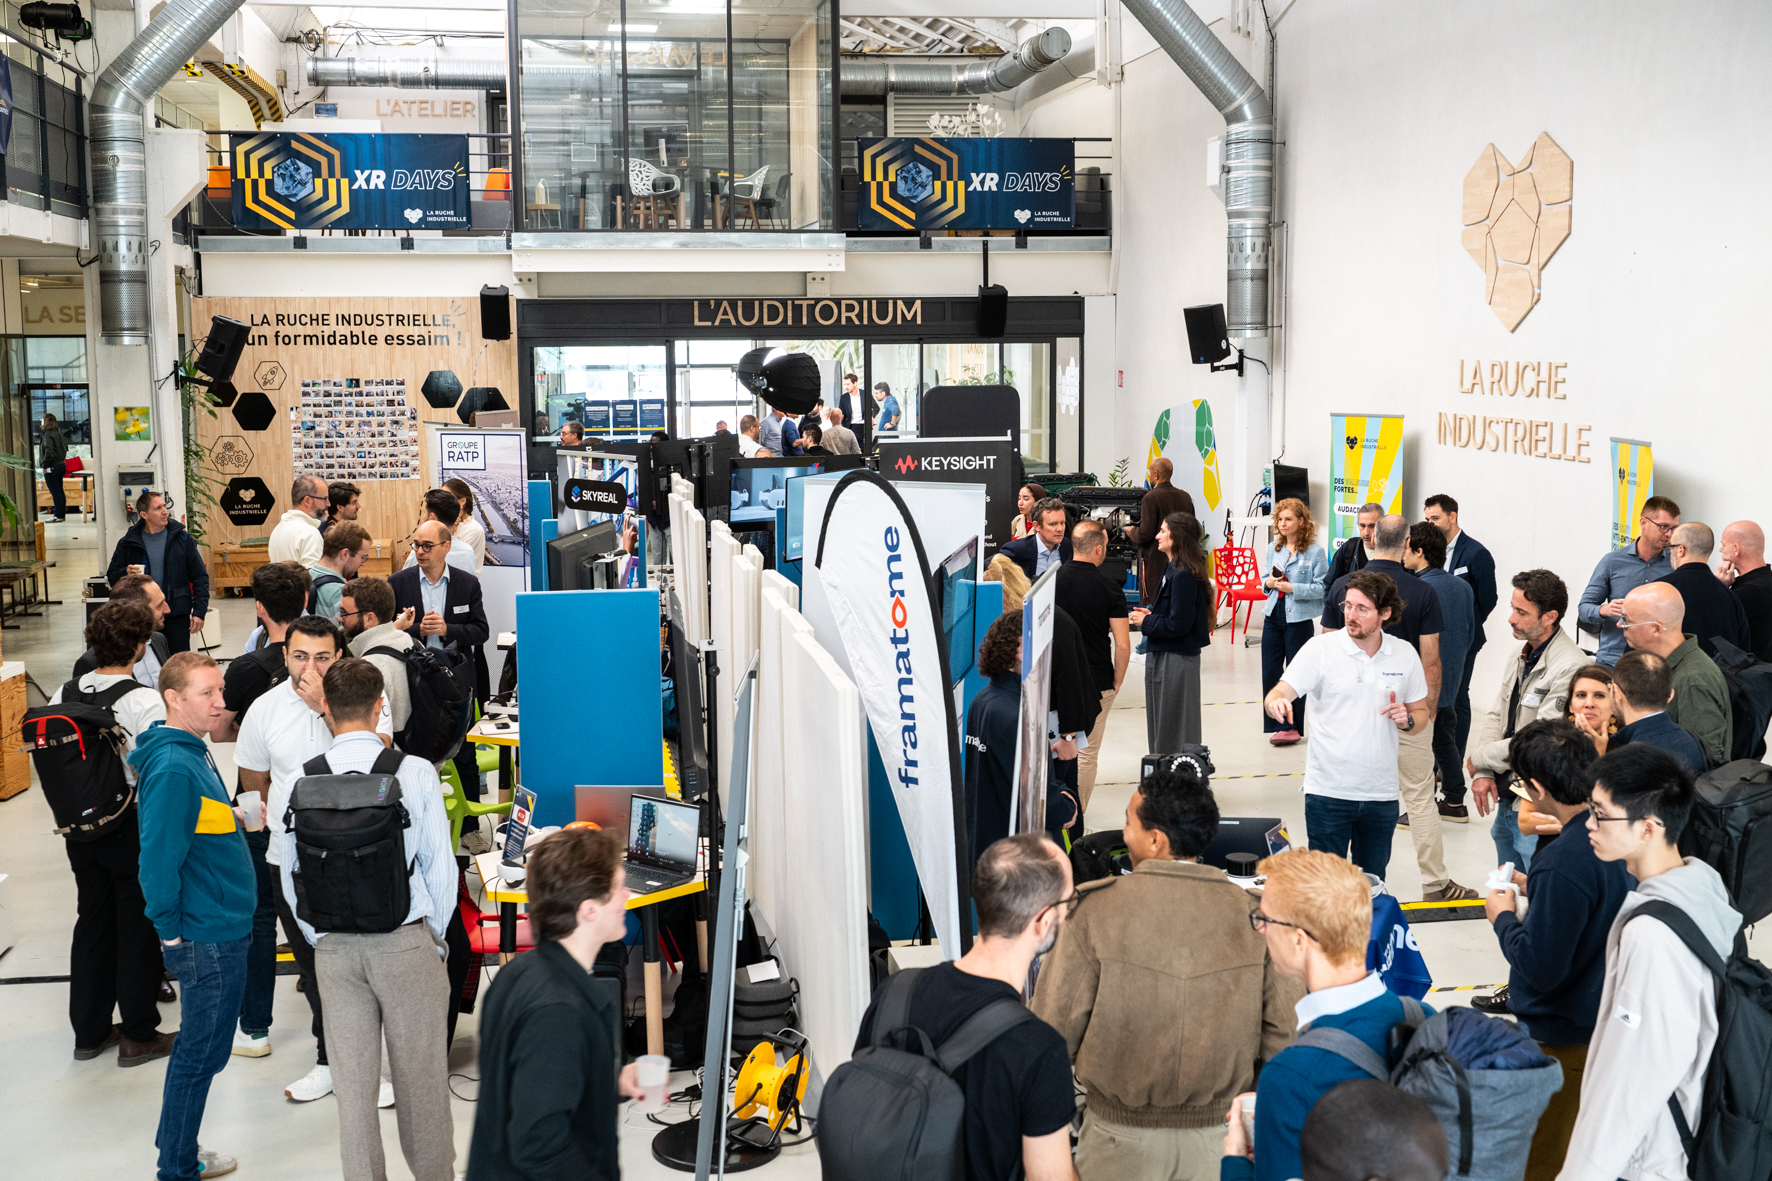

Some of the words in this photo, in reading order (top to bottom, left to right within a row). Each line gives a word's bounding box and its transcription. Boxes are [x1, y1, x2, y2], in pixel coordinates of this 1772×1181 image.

[376, 99, 476, 118] L'ATELIER
[351, 169, 387, 190] XR
[391, 169, 456, 190] DAYS
[967, 172, 1000, 192] XR
[1003, 172, 1062, 193] DAYS
[24, 305, 54, 324] LA
[59, 305, 86, 324] SE
[250, 313, 271, 327] LA
[275, 313, 331, 327] RUCHE
[335, 313, 456, 329] INDUSTRIELLE,
[693, 299, 922, 326] L'AUDITORIUM
[246, 333, 268, 346] un
[274, 330, 378, 346] formidable
[384, 330, 450, 346] essaim
[457, 330, 463, 346] !
[1458, 359, 1485, 395] LA
[1489, 360, 1568, 400] RUCHE
[447, 441, 479, 450] GROUPE
[1437, 411, 1592, 464] INDUSTRIELLE
[447, 451, 480, 463] RATP
[921, 455, 997, 471] KEYSIGHT
[1334, 477, 1344, 485] DES
[582, 489, 618, 504] SKYREAL
[884, 526, 920, 789] framatome
